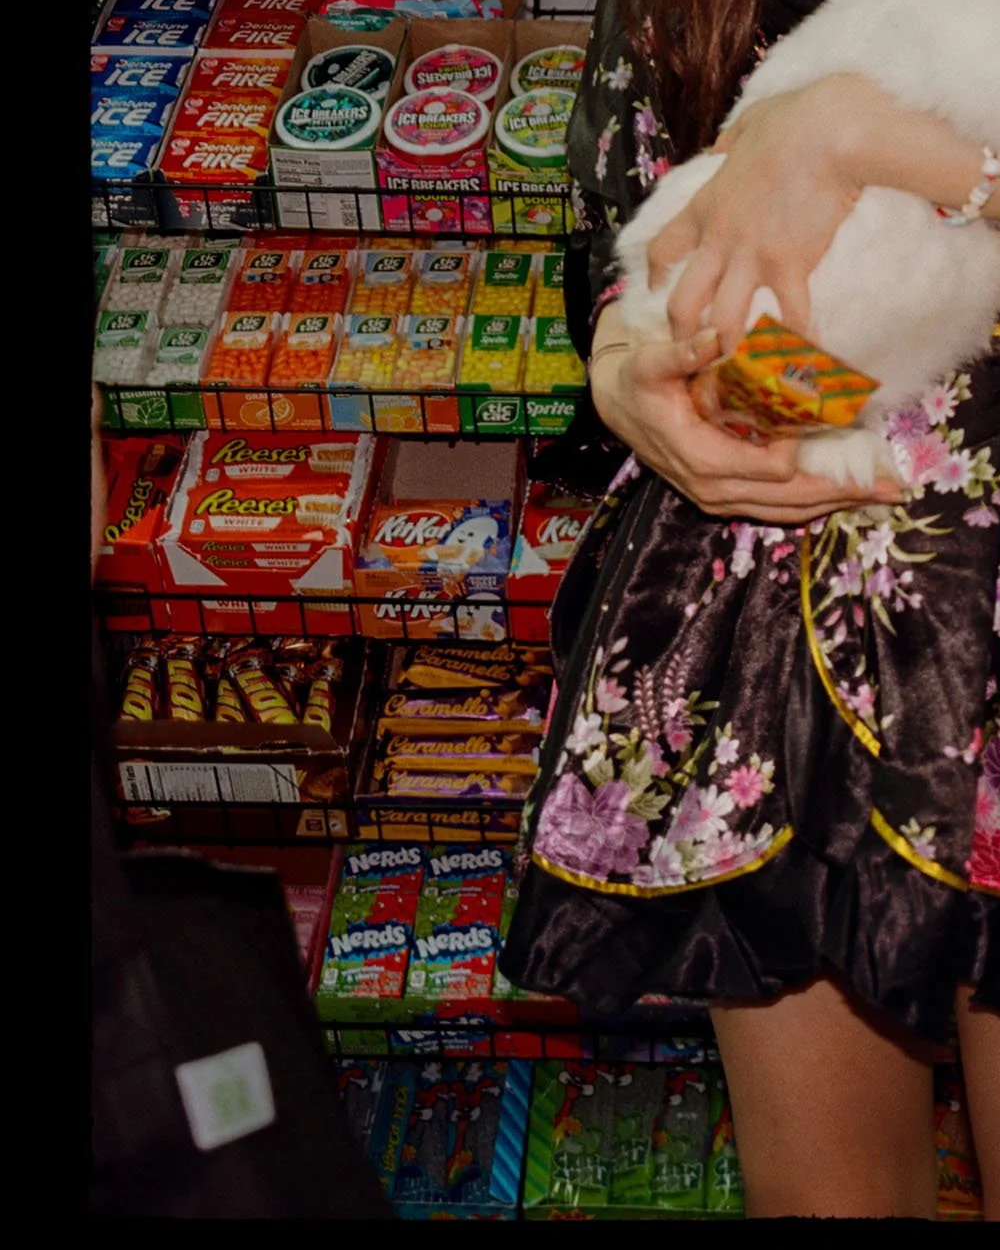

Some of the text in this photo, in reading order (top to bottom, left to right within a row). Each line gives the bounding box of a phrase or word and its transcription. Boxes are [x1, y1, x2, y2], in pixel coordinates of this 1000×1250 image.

[132, 20, 190, 32] Dentyne
[239, 21, 296, 31] Dentyne
[123, 29, 185, 45] ICE
[229, 30, 293, 45] FIRE
[114, 59, 173, 71] Dentyne
[222, 62, 280, 73] Dentyne
[104, 68, 167, 87] ICE
[212, 70, 278, 87] FIRE
[97, 98, 158, 110] Dentyne
[207, 101, 266, 113] Dentyne
[290, 105, 369, 121] ICE BREAKERS
[196, 110, 265, 127] FIRE
[398, 111, 477, 126] ICE BREAKERS
[509, 117, 528, 132] ICE
[196, 142, 256, 154] Dentyne
[90, 148, 140, 168] CE
[183, 150, 252, 169] FIRE
[387, 176, 481, 191] ICE BREAKERS
[142, 253, 157, 262] tic
[201, 253, 217, 262] tic
[263, 253, 280, 261] tic
[321, 254, 338, 262] tic
[388, 255, 404, 264] tic
[444, 255, 461, 264] tic
[129, 259, 155, 267] tac
[189, 258, 215, 267] tac
[250, 259, 276, 268] tac
[309, 260, 334, 269] tac
[376, 262, 401, 271] tac
[433, 262, 457, 271] tac
[121, 315, 137, 323] tic
[248, 316, 265, 325] tic
[311, 317, 327, 326] tic
[368, 318, 389, 327] tic
[426, 318, 447, 327] tic
[111, 320, 135, 329] tac
[235, 322, 260, 331] tac
[298, 323, 323, 332] tac
[361, 324, 385, 333] tac
[419, 324, 442, 333] tac
[180, 332, 198, 341] tic
[480, 335, 510, 346] Sprite
[168, 338, 191, 347] tac
[109, 390, 167, 400] FESHMINTS
[487, 402, 514, 413] tic
[526, 401, 576, 418] Sprite
[481, 410, 512, 421] tac
[210, 439, 311, 464] Reese's
[238, 465, 279, 474] WHITE
[196, 489, 297, 516] Reese's
[223, 518, 265, 526] WHITE
[264, 543, 299, 551] WHITE
[267, 558, 301, 567] WHITE
[216, 600, 262, 609] WHIE
[383, 694, 490, 718] Caramello
[386, 736, 493, 756] Caramello
